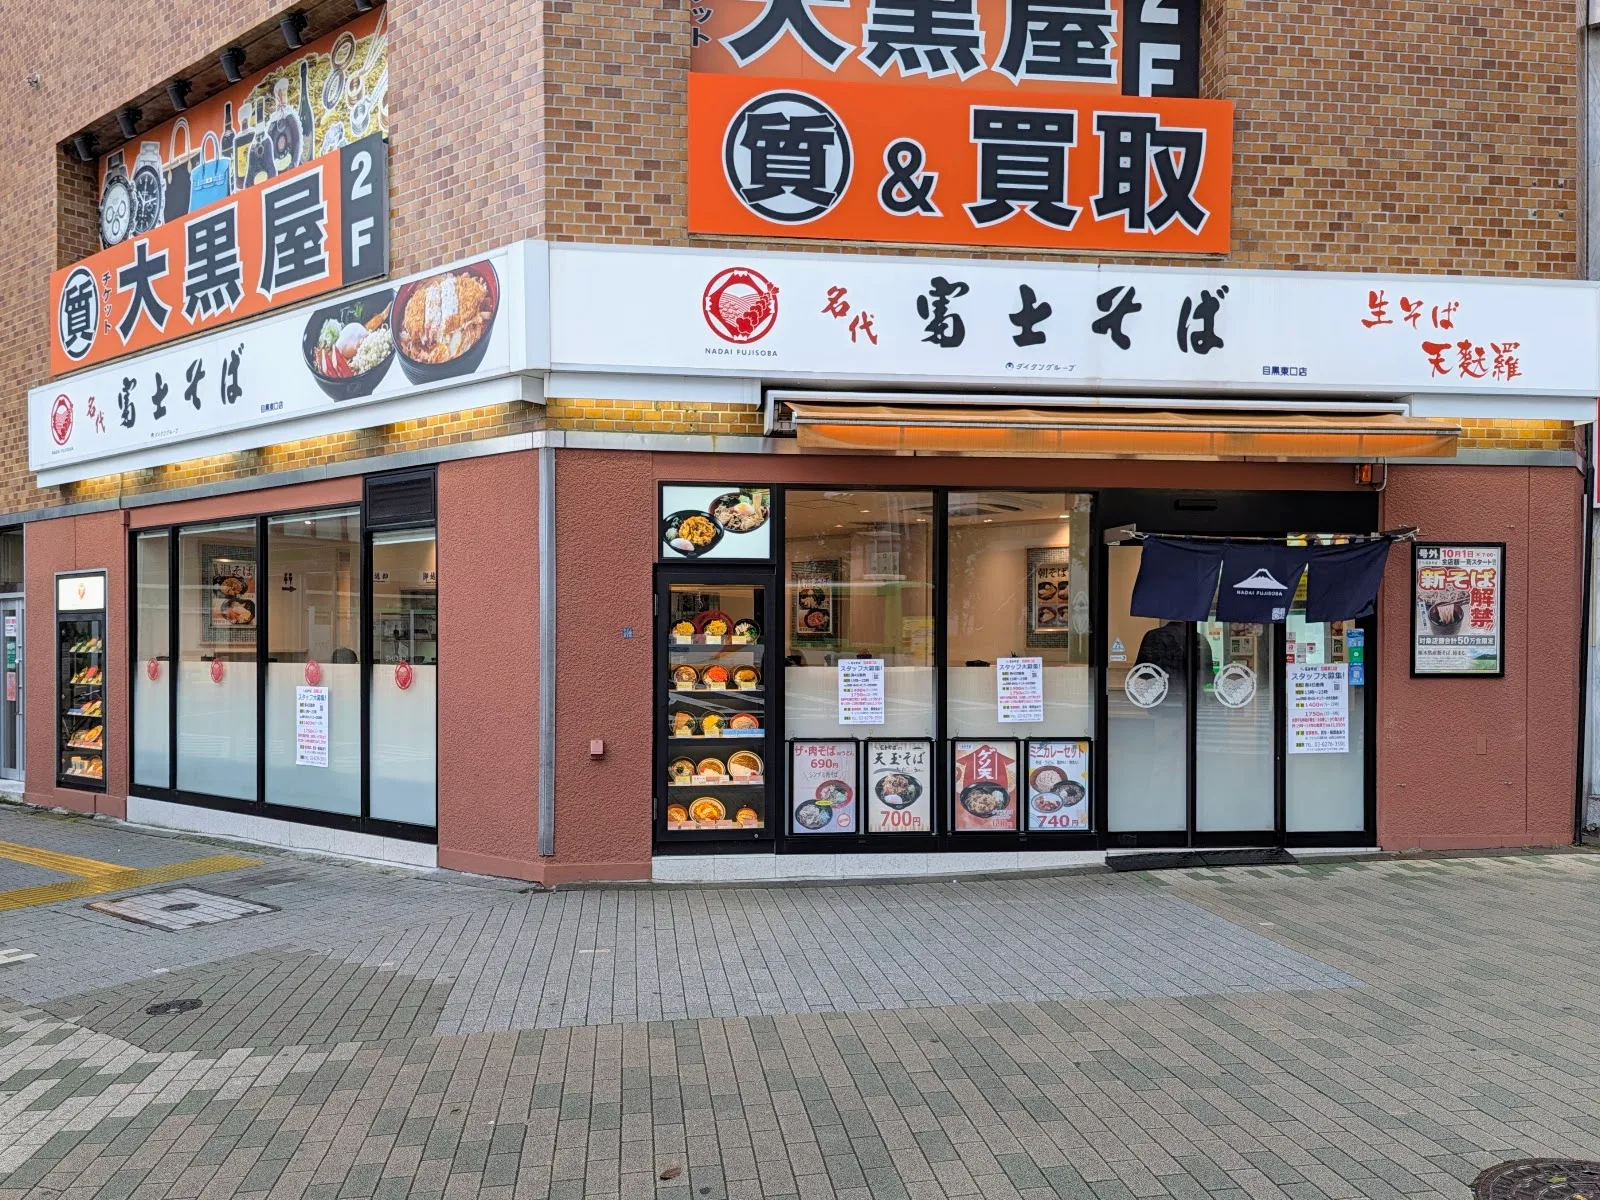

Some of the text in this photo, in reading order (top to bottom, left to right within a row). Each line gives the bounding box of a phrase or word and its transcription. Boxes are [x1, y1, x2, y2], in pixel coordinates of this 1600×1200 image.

[692, 0, 713, 47] ット
[738, 104, 1210, 235] 質 & 買取
[115, 165, 330, 347] 大黒屋
[102, 271, 112, 335] チケット
[1361, 289, 1460, 330] 生そば
[63, 276, 97, 352] 質
[821, 275, 1230, 356] 名代 富士そば
[705, 347, 778, 357] NADAI FUJISOBA
[1262, 365, 1308, 377] 目黒東口店
[86, 342, 245, 434] 名代 富士そば
[260, 401, 284, 413] 目黒東口店
[1418, 548, 1439, 559] 号外
[1442, 549, 1474, 558] 10月1日
[1038, 567, 1068, 578] 朝そば
[1420, 568, 1496, 590] 新そば
[794, 745, 836, 756] ザ・肉そば
[873, 751, 926, 766] 天玉そば
[1029, 744, 1085, 758] ミニカレーセット
[810, 759, 839, 768] 690円
[880, 810, 921, 827] 700円
[1037, 815, 1079, 828] 740円
